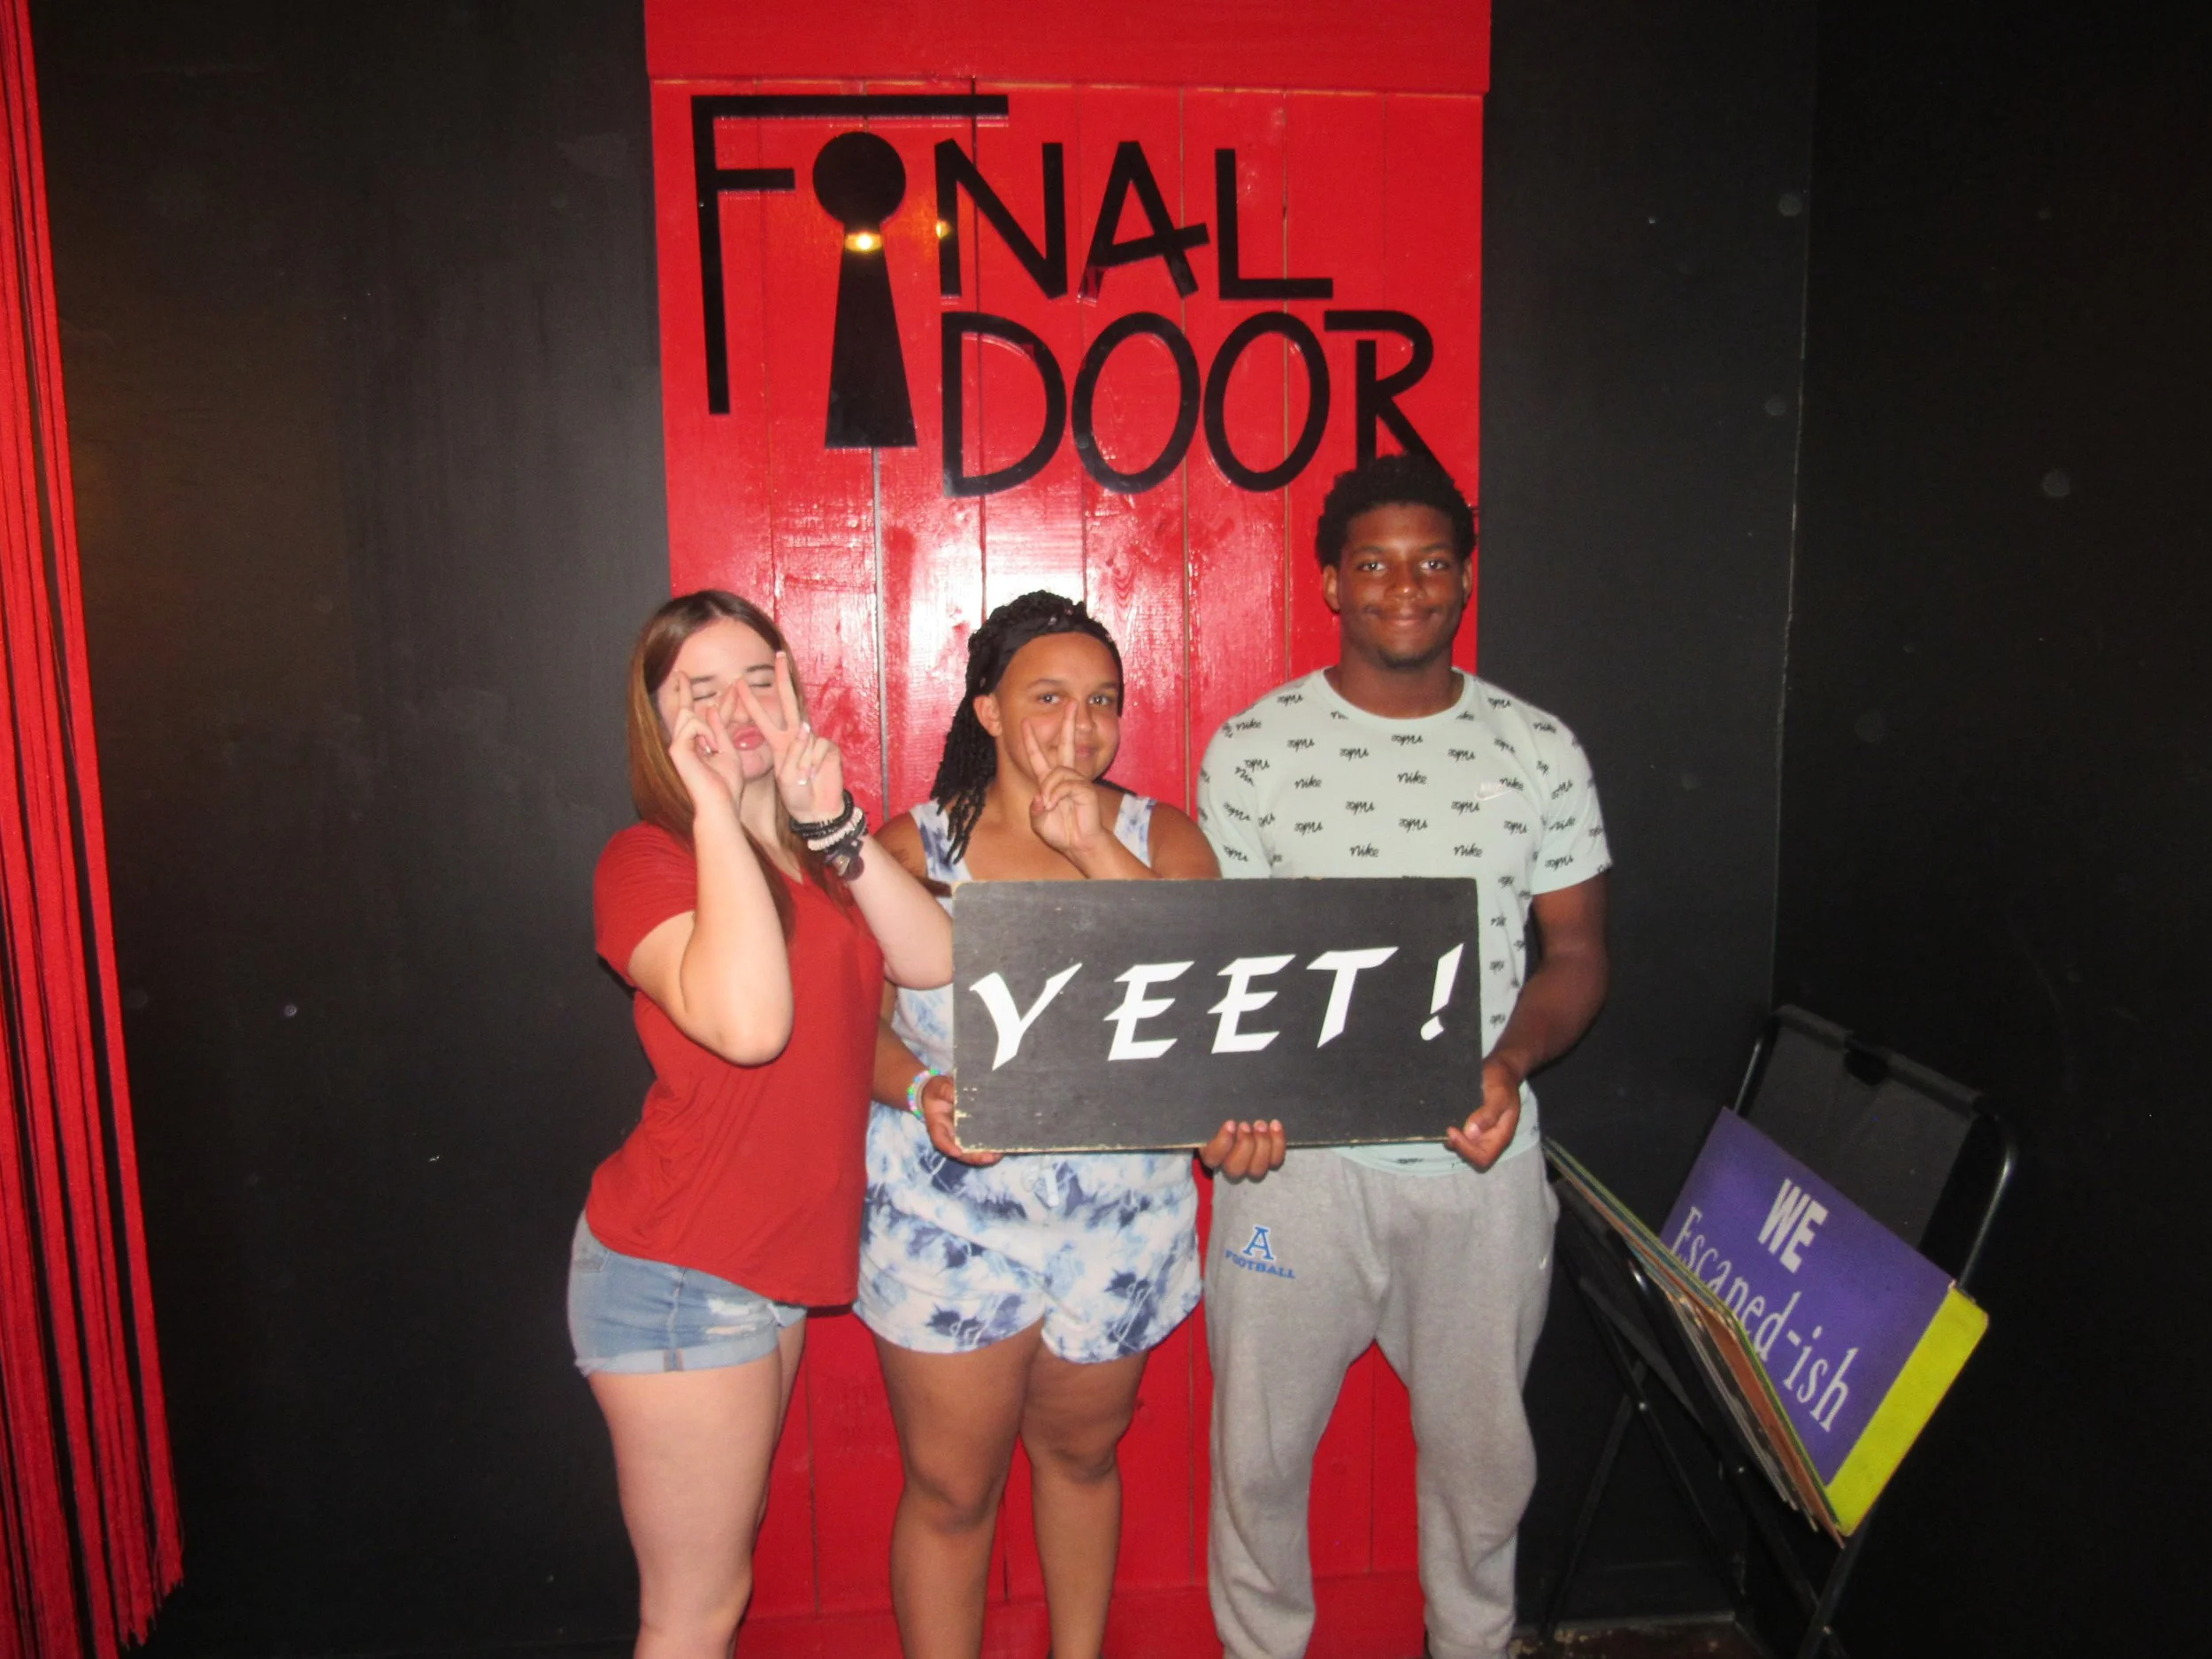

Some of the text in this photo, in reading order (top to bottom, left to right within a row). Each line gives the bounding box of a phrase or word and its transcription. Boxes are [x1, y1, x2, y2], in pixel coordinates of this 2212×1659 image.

[941, 310, 1453, 498] DOOR
[969, 942, 1464, 1072] YEET!
[1224, 1248, 1296, 1279] FOOTBALL
[1240, 1225, 1276, 1262] A
[1757, 1178, 1829, 1274] WE
